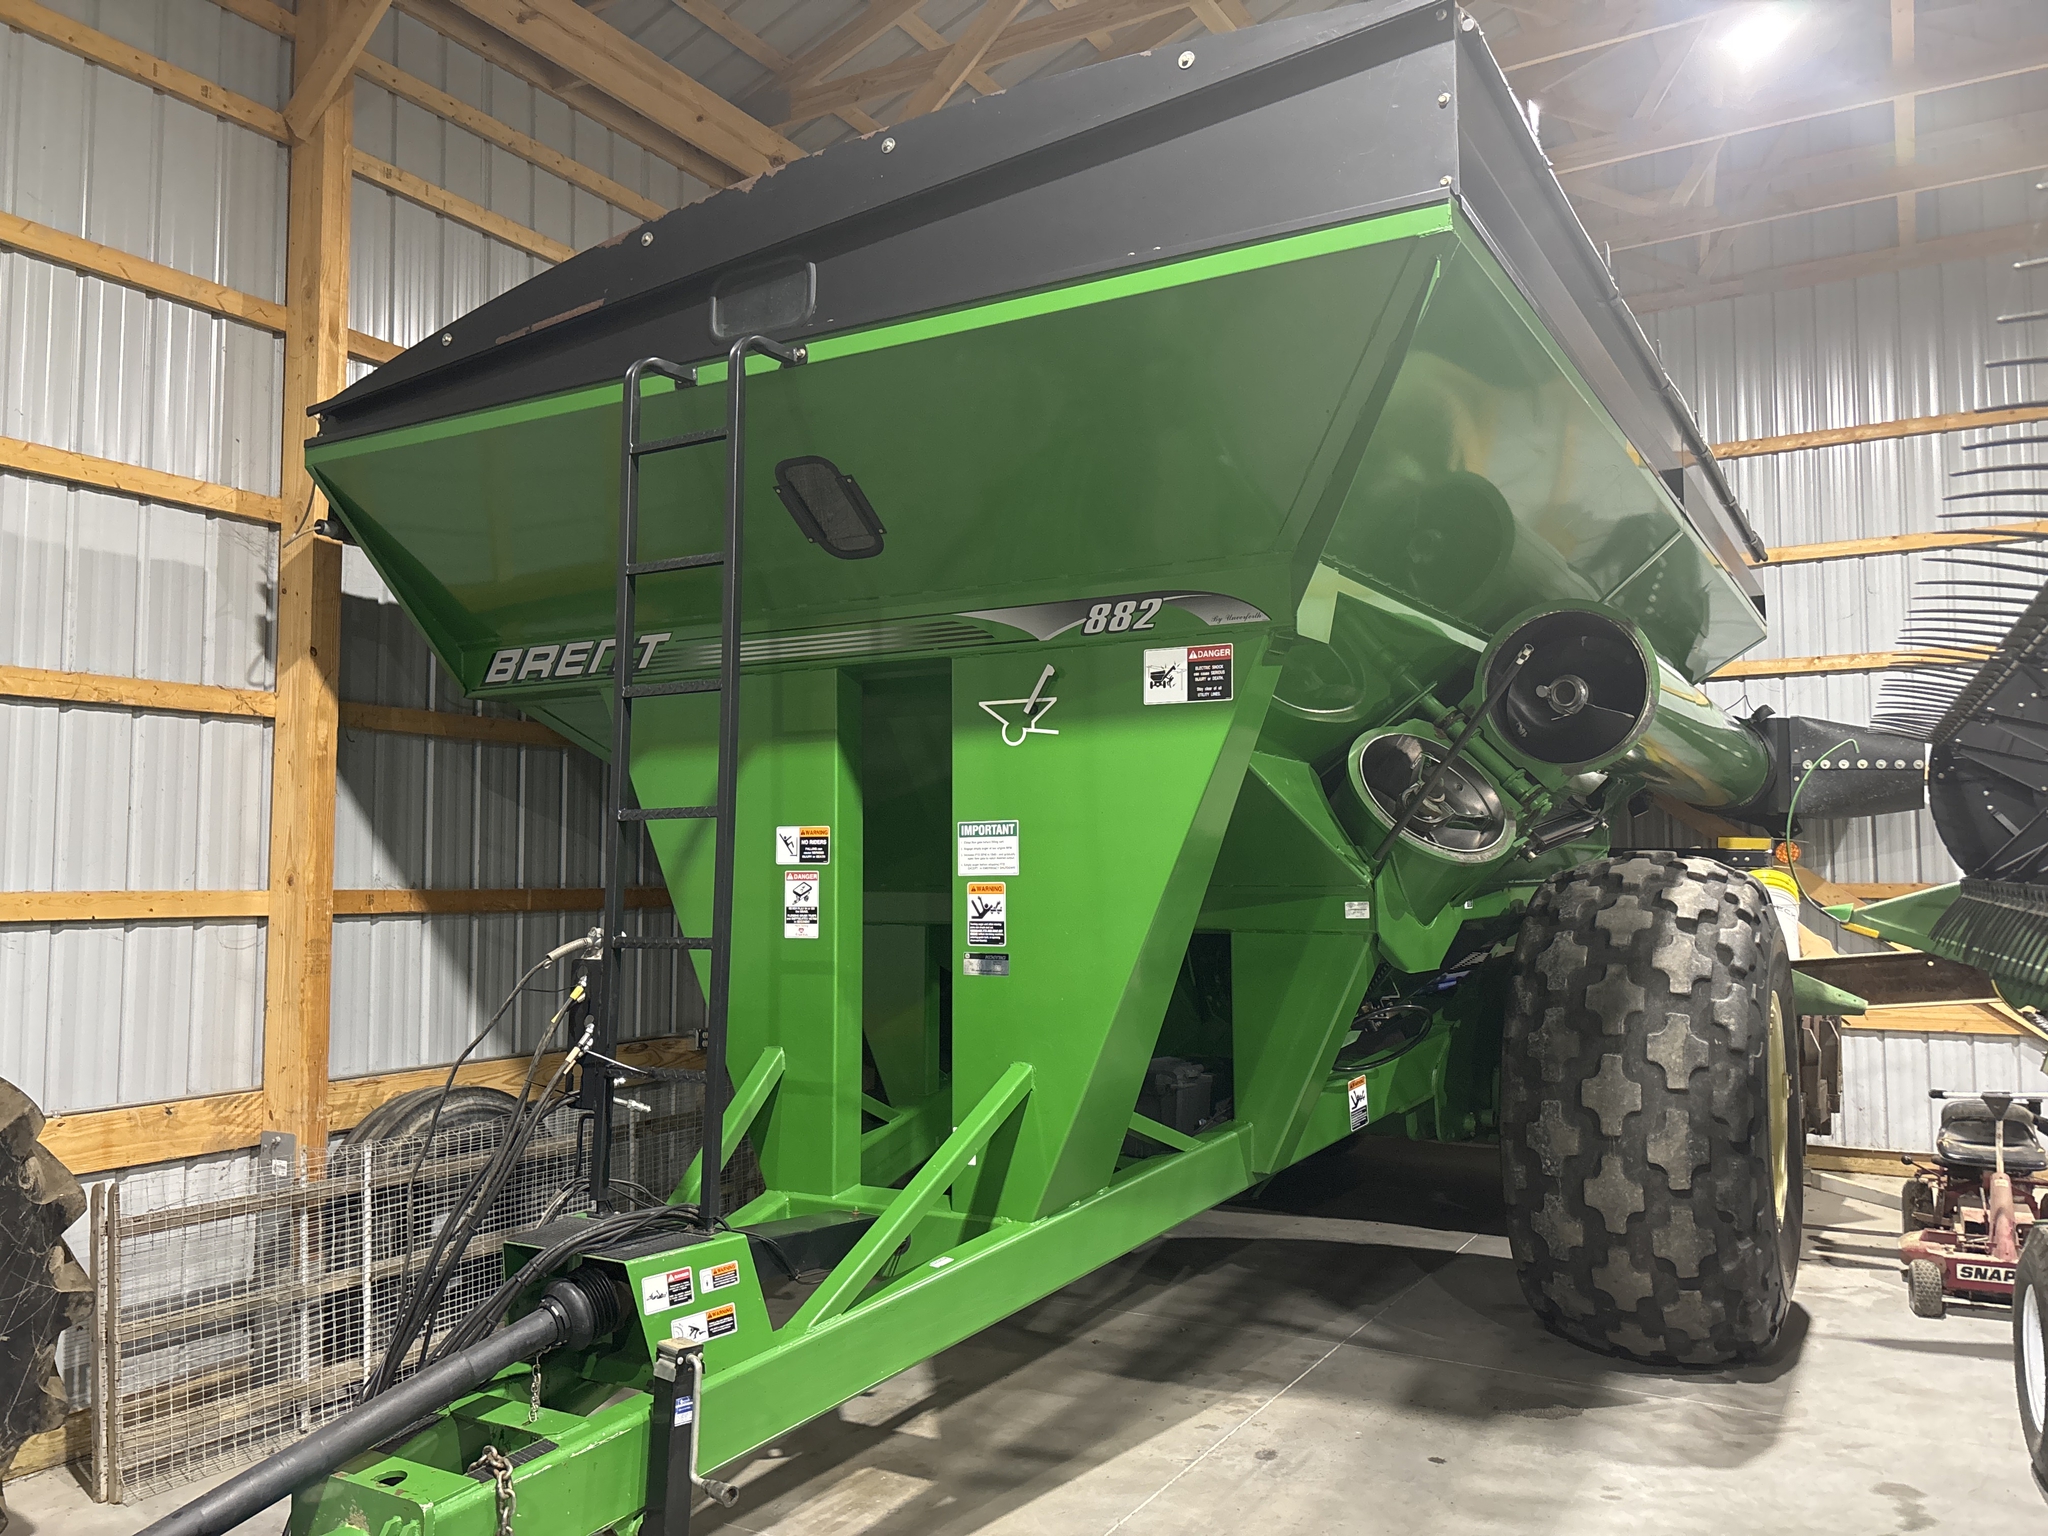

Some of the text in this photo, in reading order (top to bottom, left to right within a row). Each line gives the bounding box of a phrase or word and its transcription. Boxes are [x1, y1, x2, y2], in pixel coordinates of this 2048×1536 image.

[1083, 598, 1163, 635] 882
[1197, 648, 1231, 658] DANGER
[961, 824, 1015, 836] IMPORTANT
